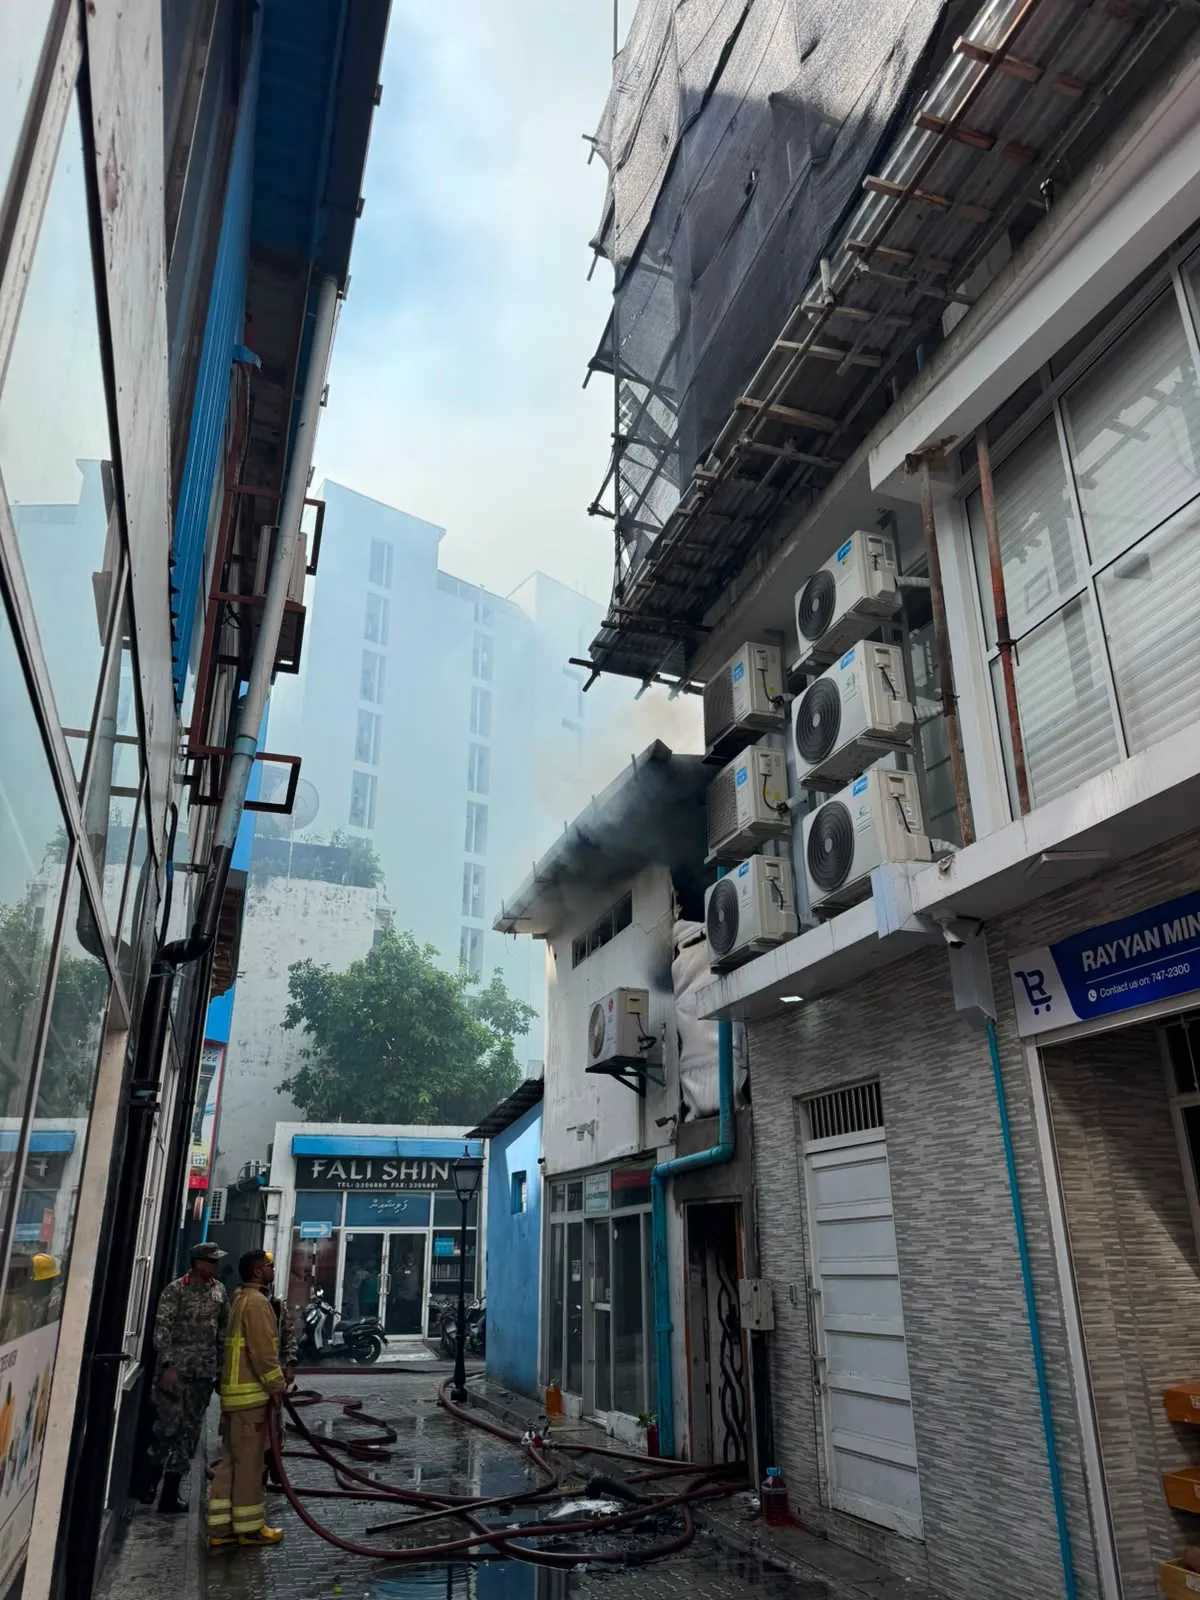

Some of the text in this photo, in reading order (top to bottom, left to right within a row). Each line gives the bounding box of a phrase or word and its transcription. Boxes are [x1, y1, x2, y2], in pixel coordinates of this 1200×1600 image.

[1082, 912, 1200, 972] RAYYAN MIN
[1100, 982, 1128, 998] Contact
[1129, 980, 1138, 989] us
[1151, 963, 1190, 982] 747-2300
[311, 1159, 373, 1180] FALI
